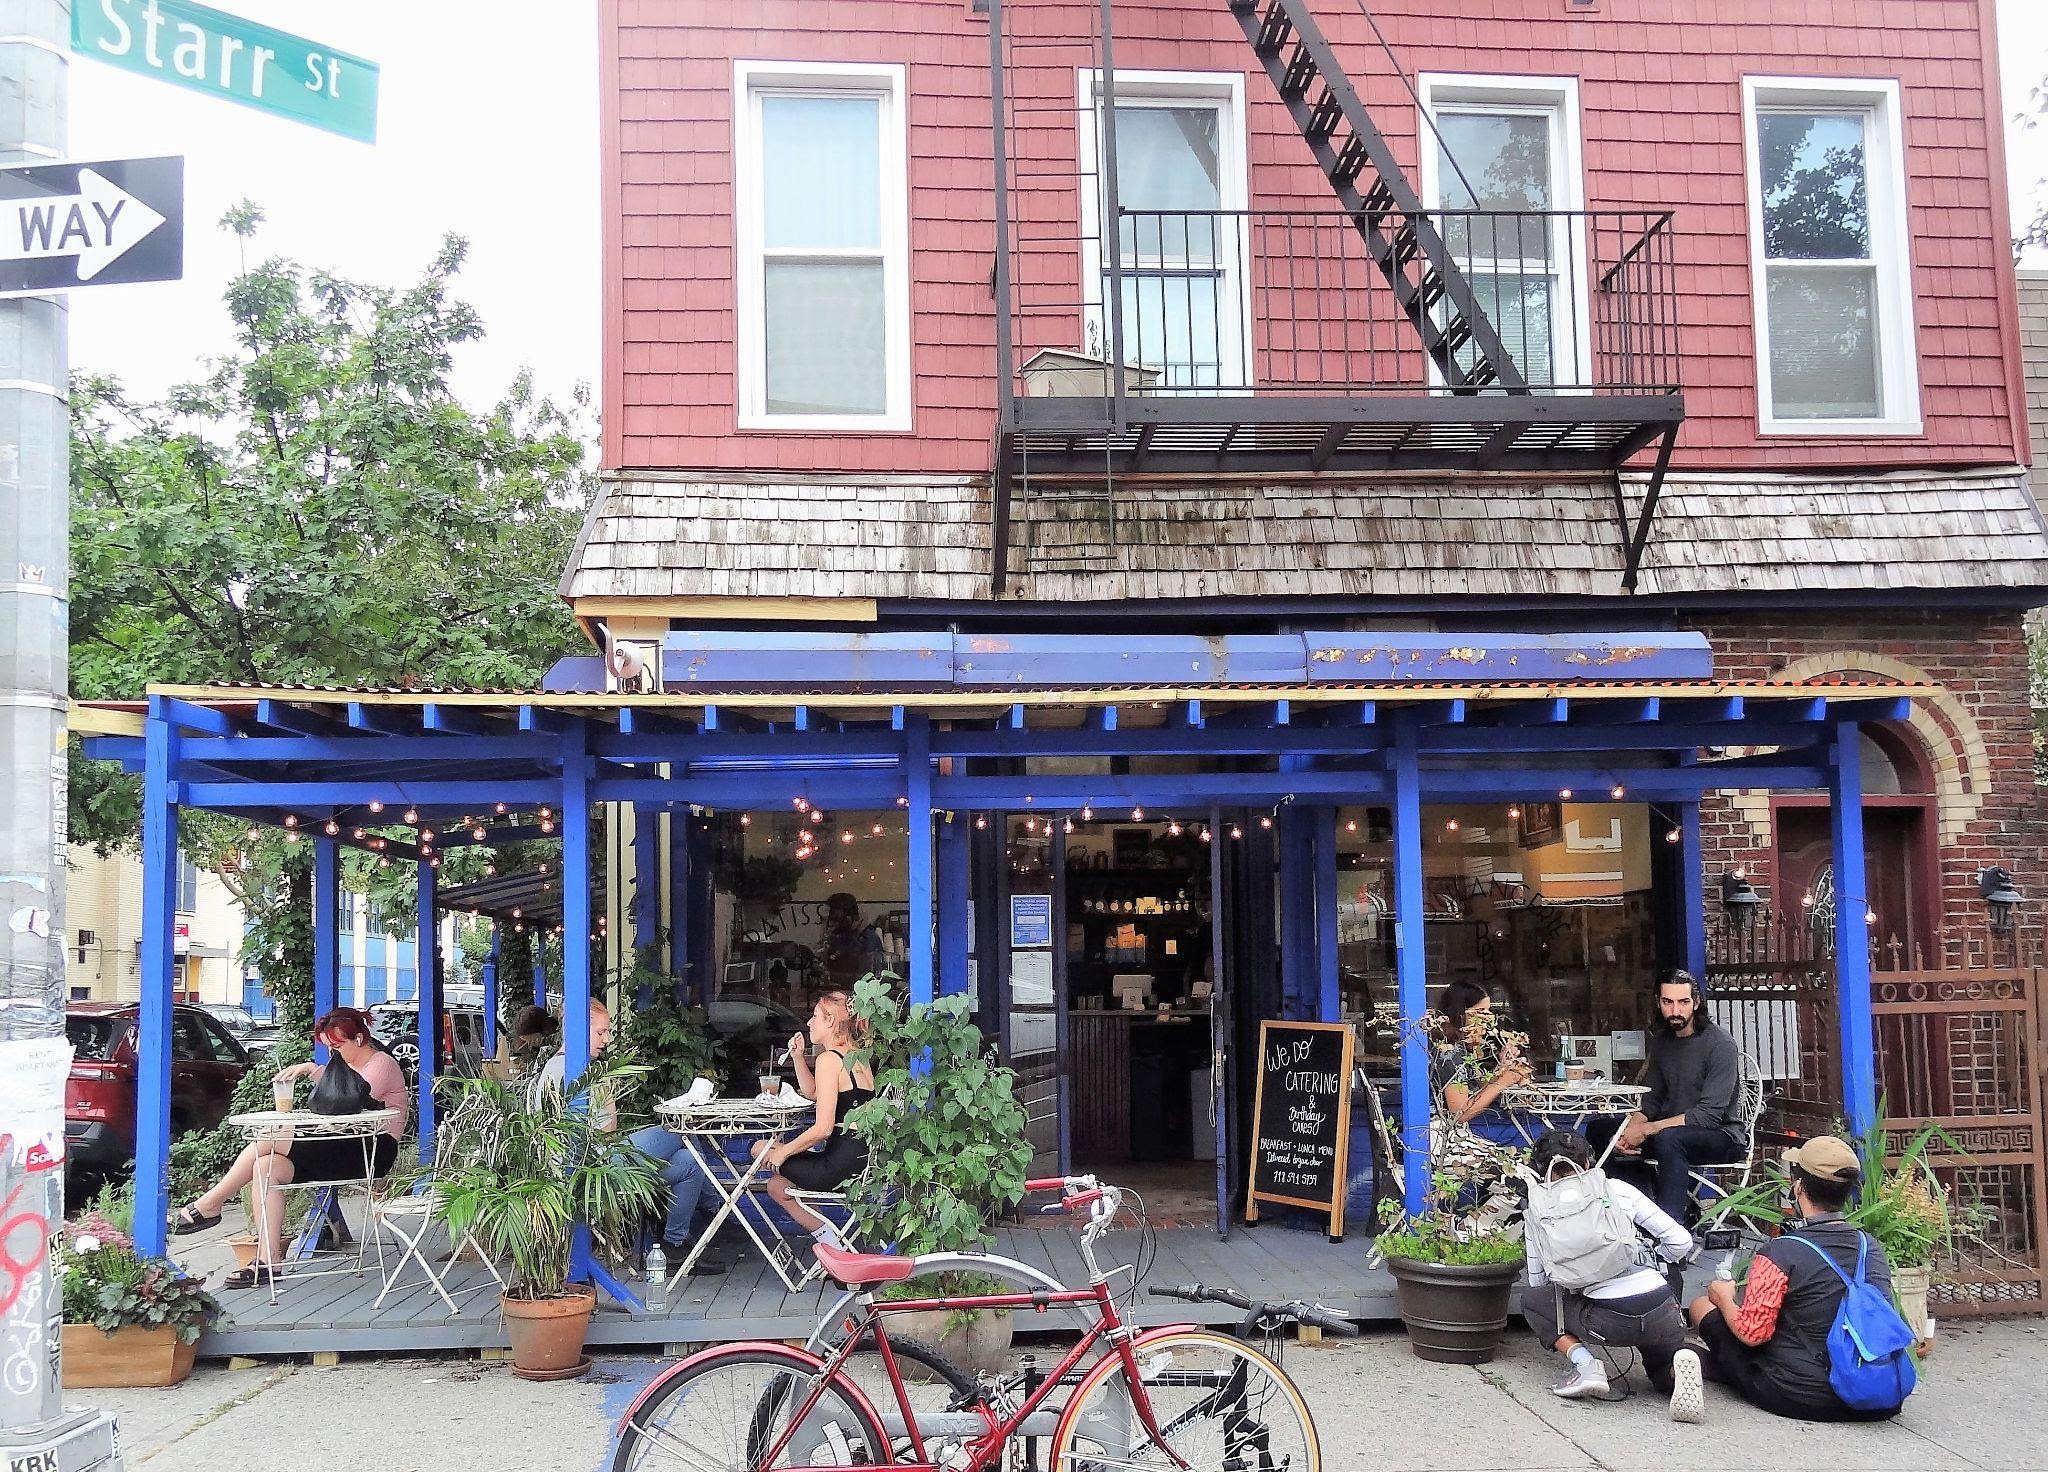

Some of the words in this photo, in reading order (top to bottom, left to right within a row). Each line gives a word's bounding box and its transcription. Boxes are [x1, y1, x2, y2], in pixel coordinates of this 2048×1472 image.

[98, 0, 275, 98] Starr
[305, 52, 342, 98] St
[19, 199, 127, 252] WAY
[1285, 1071, 1338, 1094] CATERING
[1309, 1095, 1316, 1109] &
[1260, 1137, 1293, 1151] BREAKFAST
